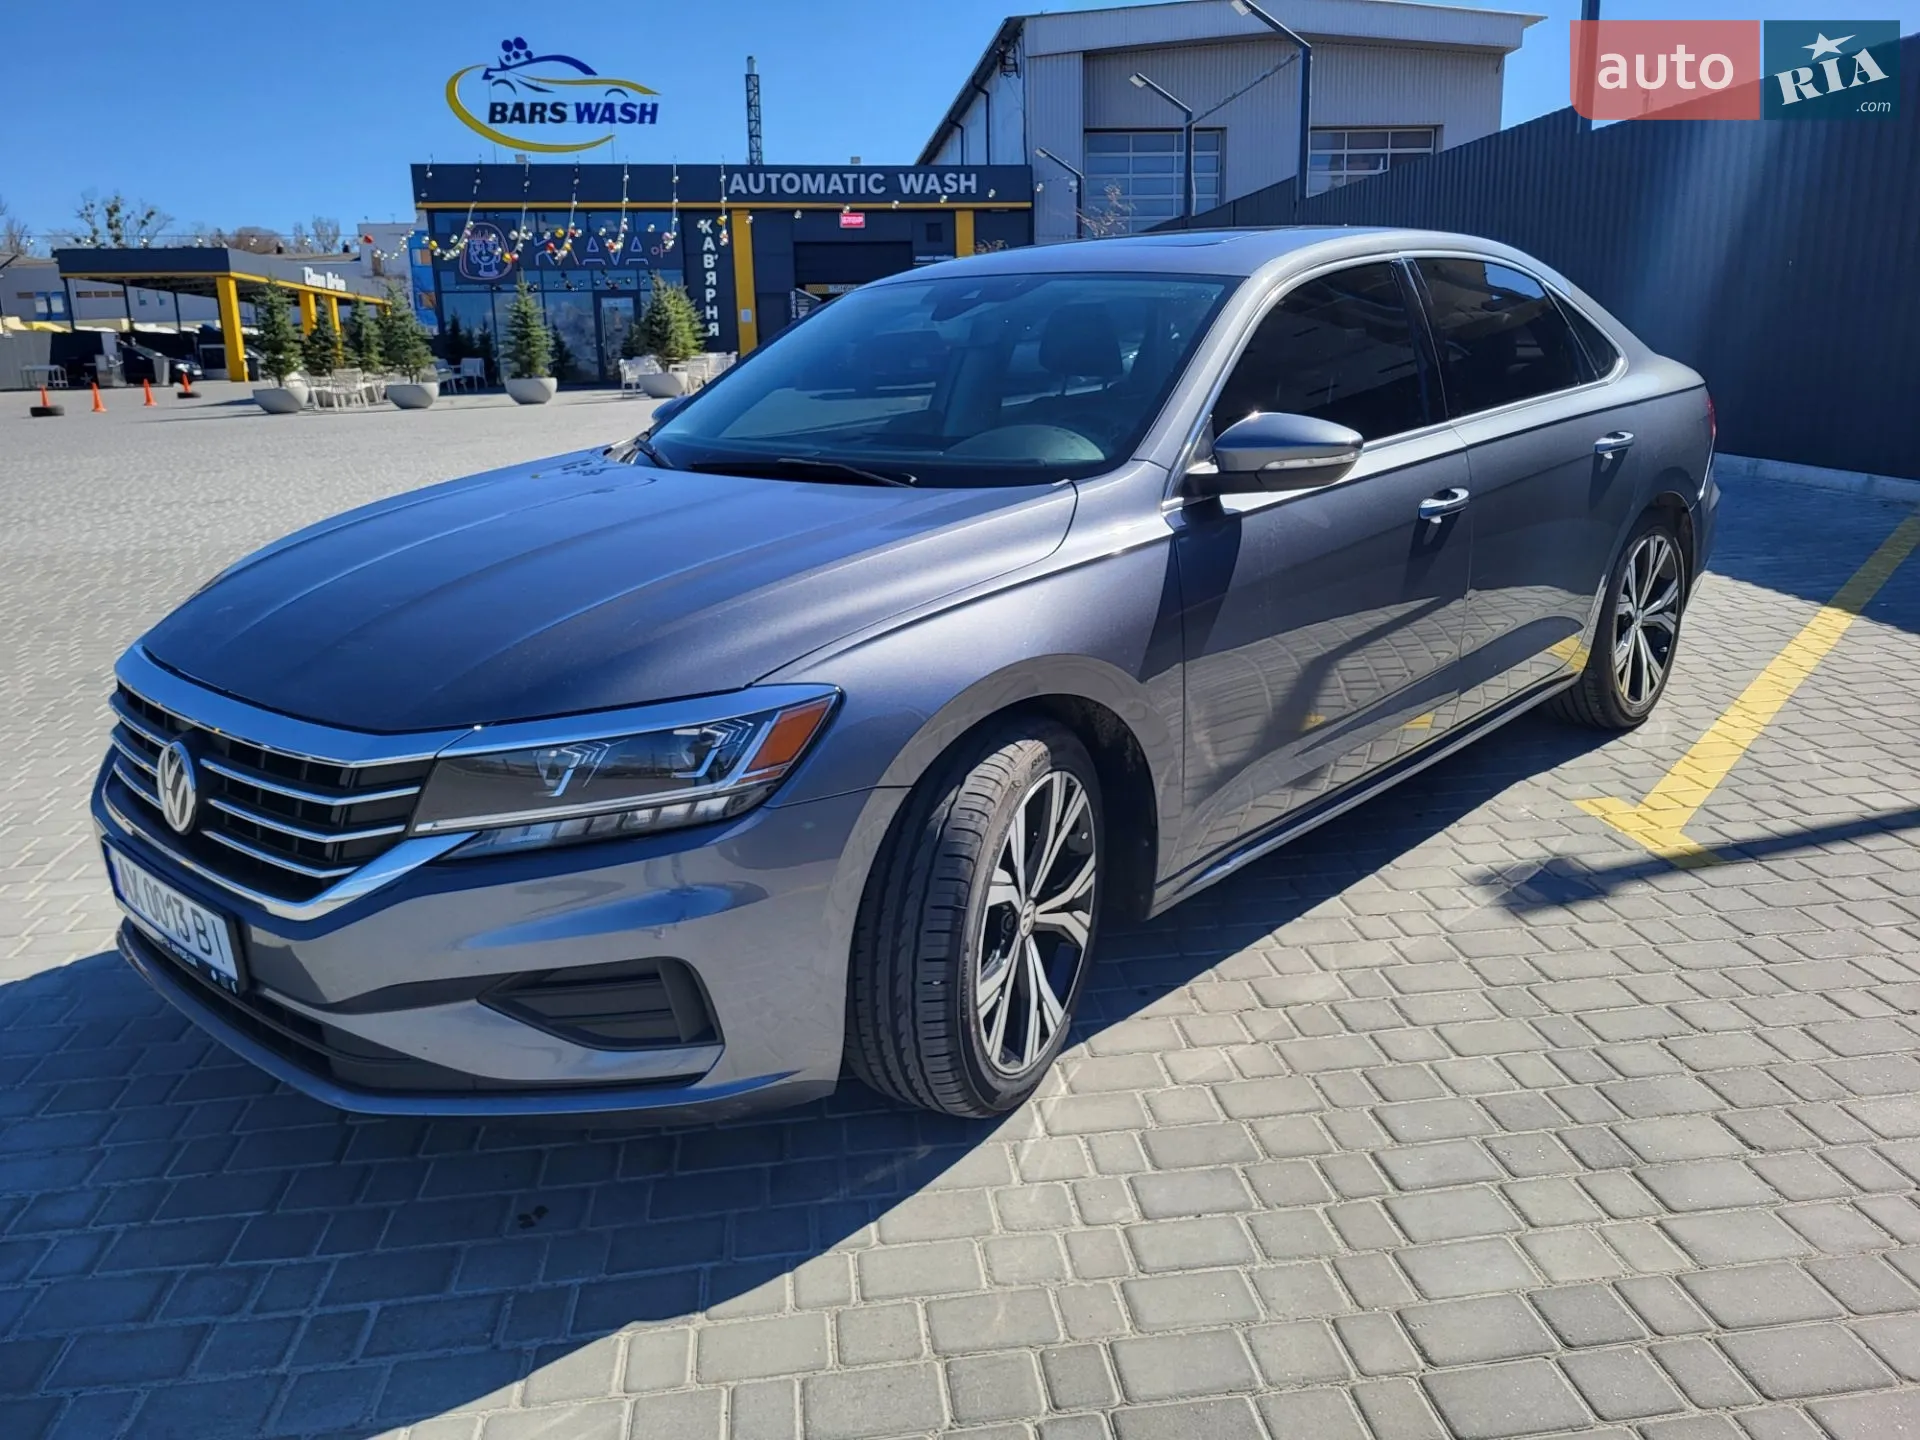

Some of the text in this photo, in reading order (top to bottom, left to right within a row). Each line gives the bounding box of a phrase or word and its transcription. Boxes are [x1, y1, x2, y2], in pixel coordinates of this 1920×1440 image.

[488, 102, 659, 125] BARS WASH
[728, 172, 978, 195] AUTOMATIC WASH
[701, 218, 720, 337] КАВ'ЯРНЯ
[143, 876, 191, 943] 0013
[190, 906, 226, 965] BI
